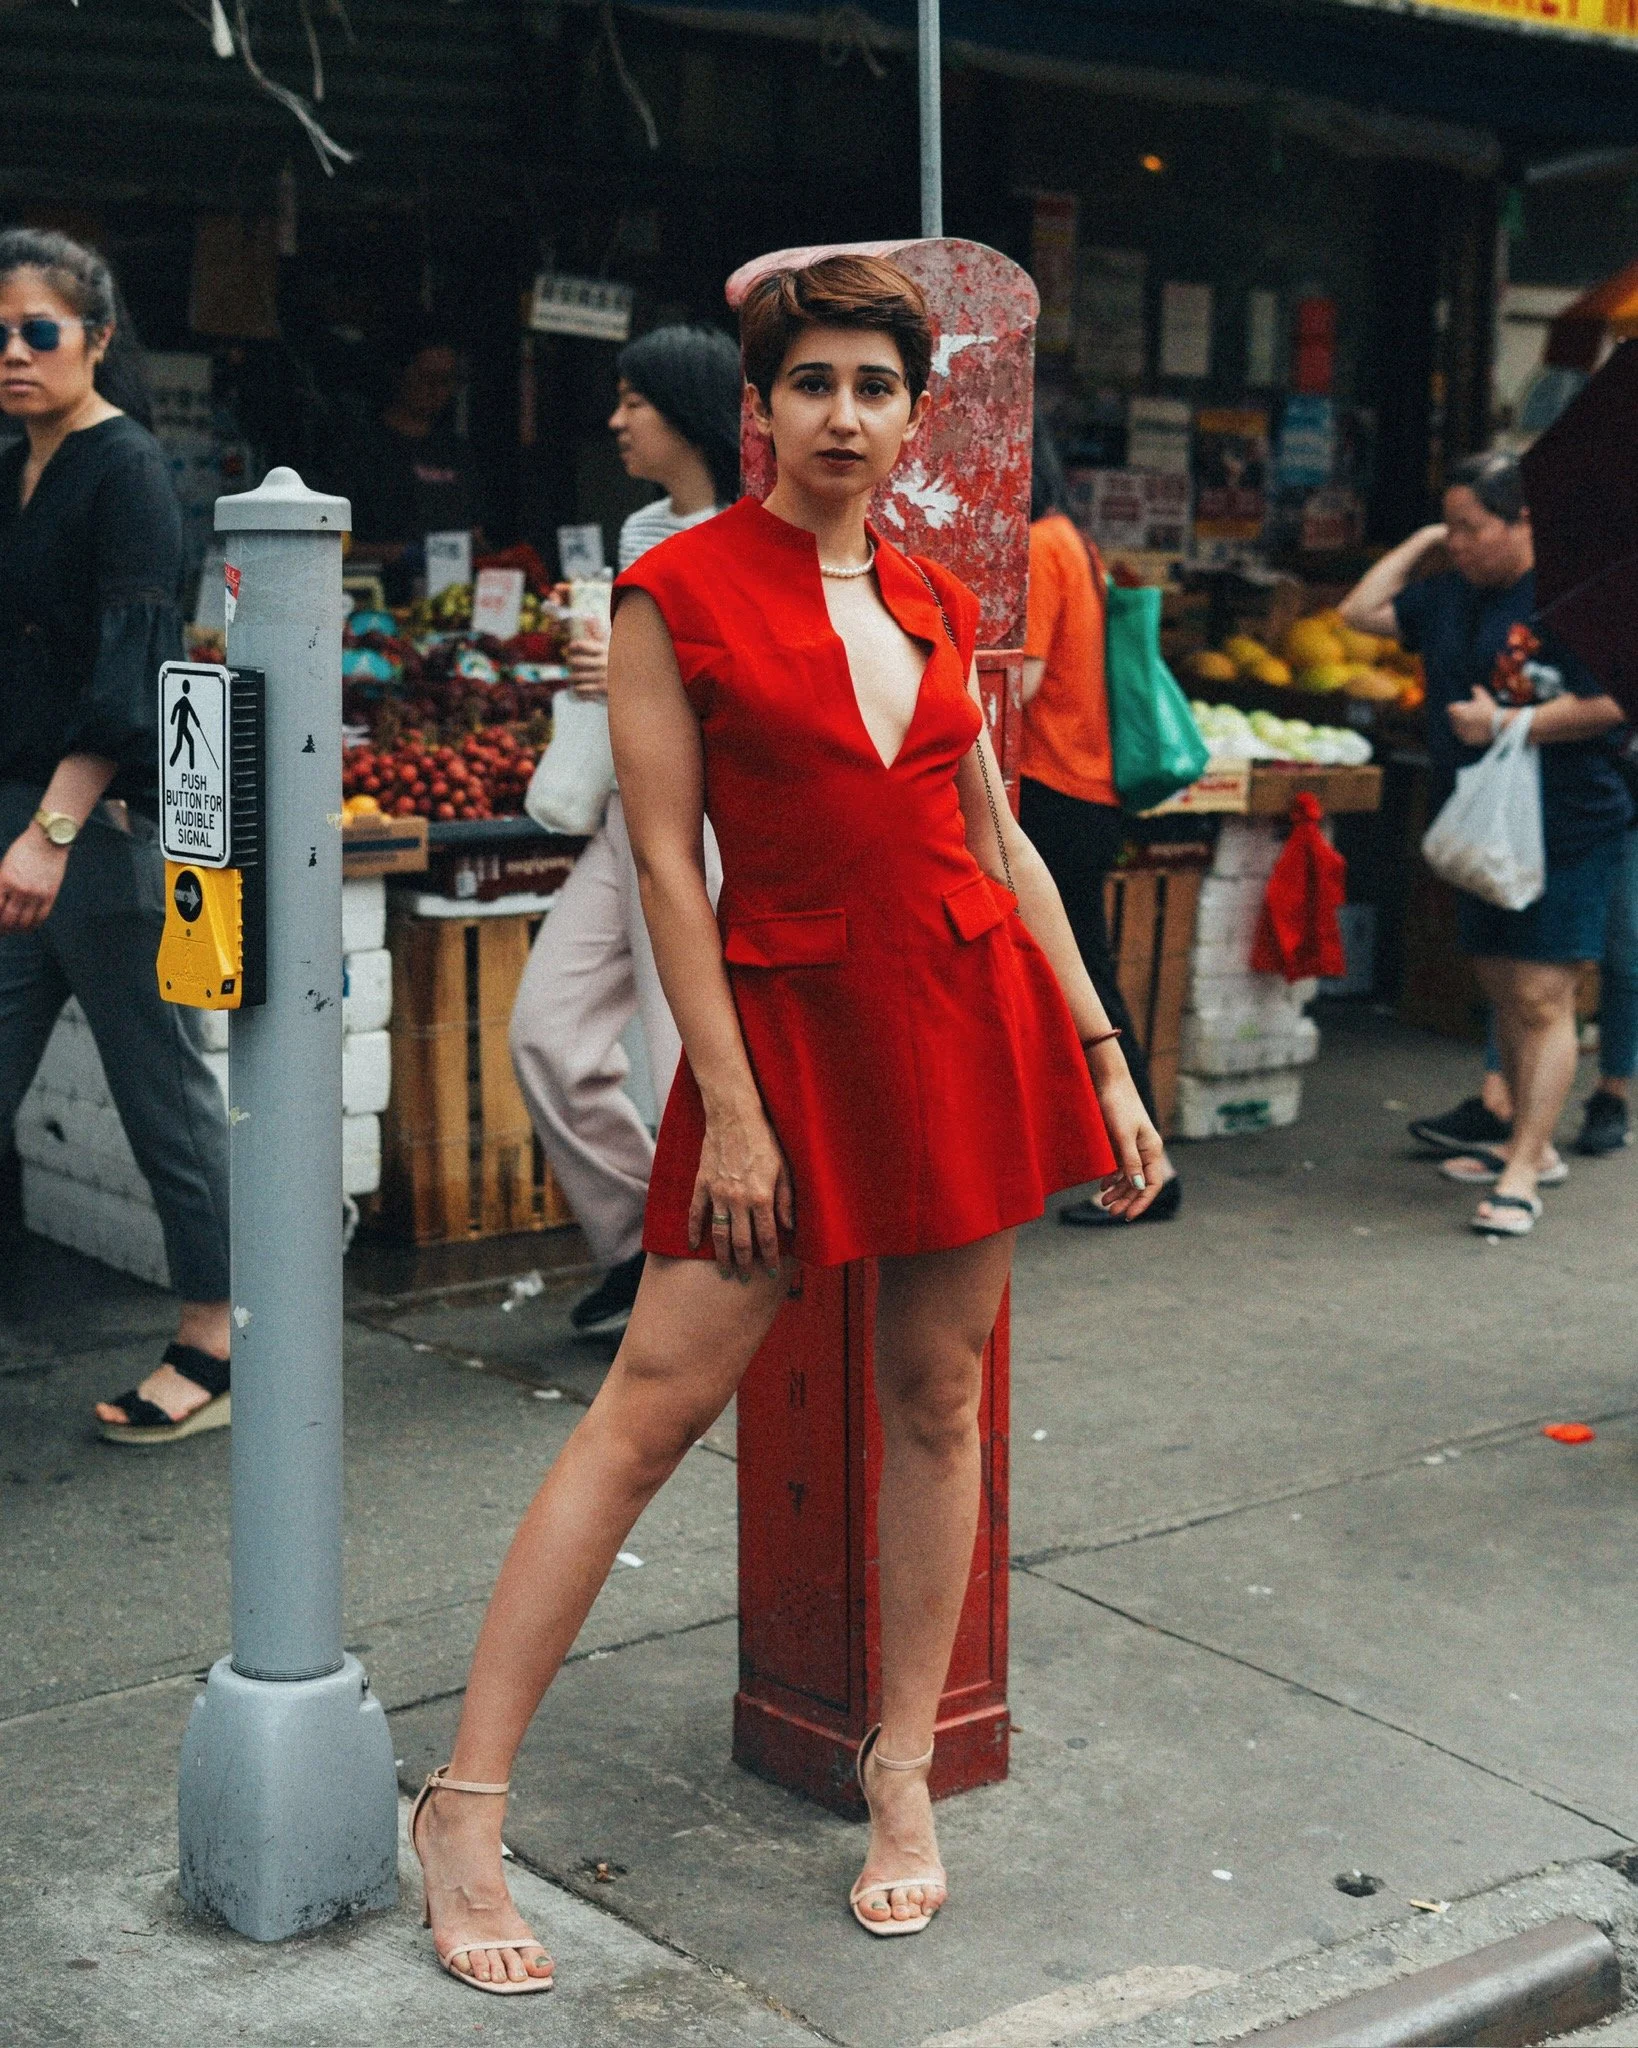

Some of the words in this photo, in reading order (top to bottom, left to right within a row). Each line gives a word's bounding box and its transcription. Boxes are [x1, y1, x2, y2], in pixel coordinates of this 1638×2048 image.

[181, 773, 206, 791] PUSH
[166, 789, 201, 809] BUTTON
[204, 794, 222, 812] FOR
[175, 809, 214, 829] AUDIBLE
[178, 828, 212, 848] SIGNAL
